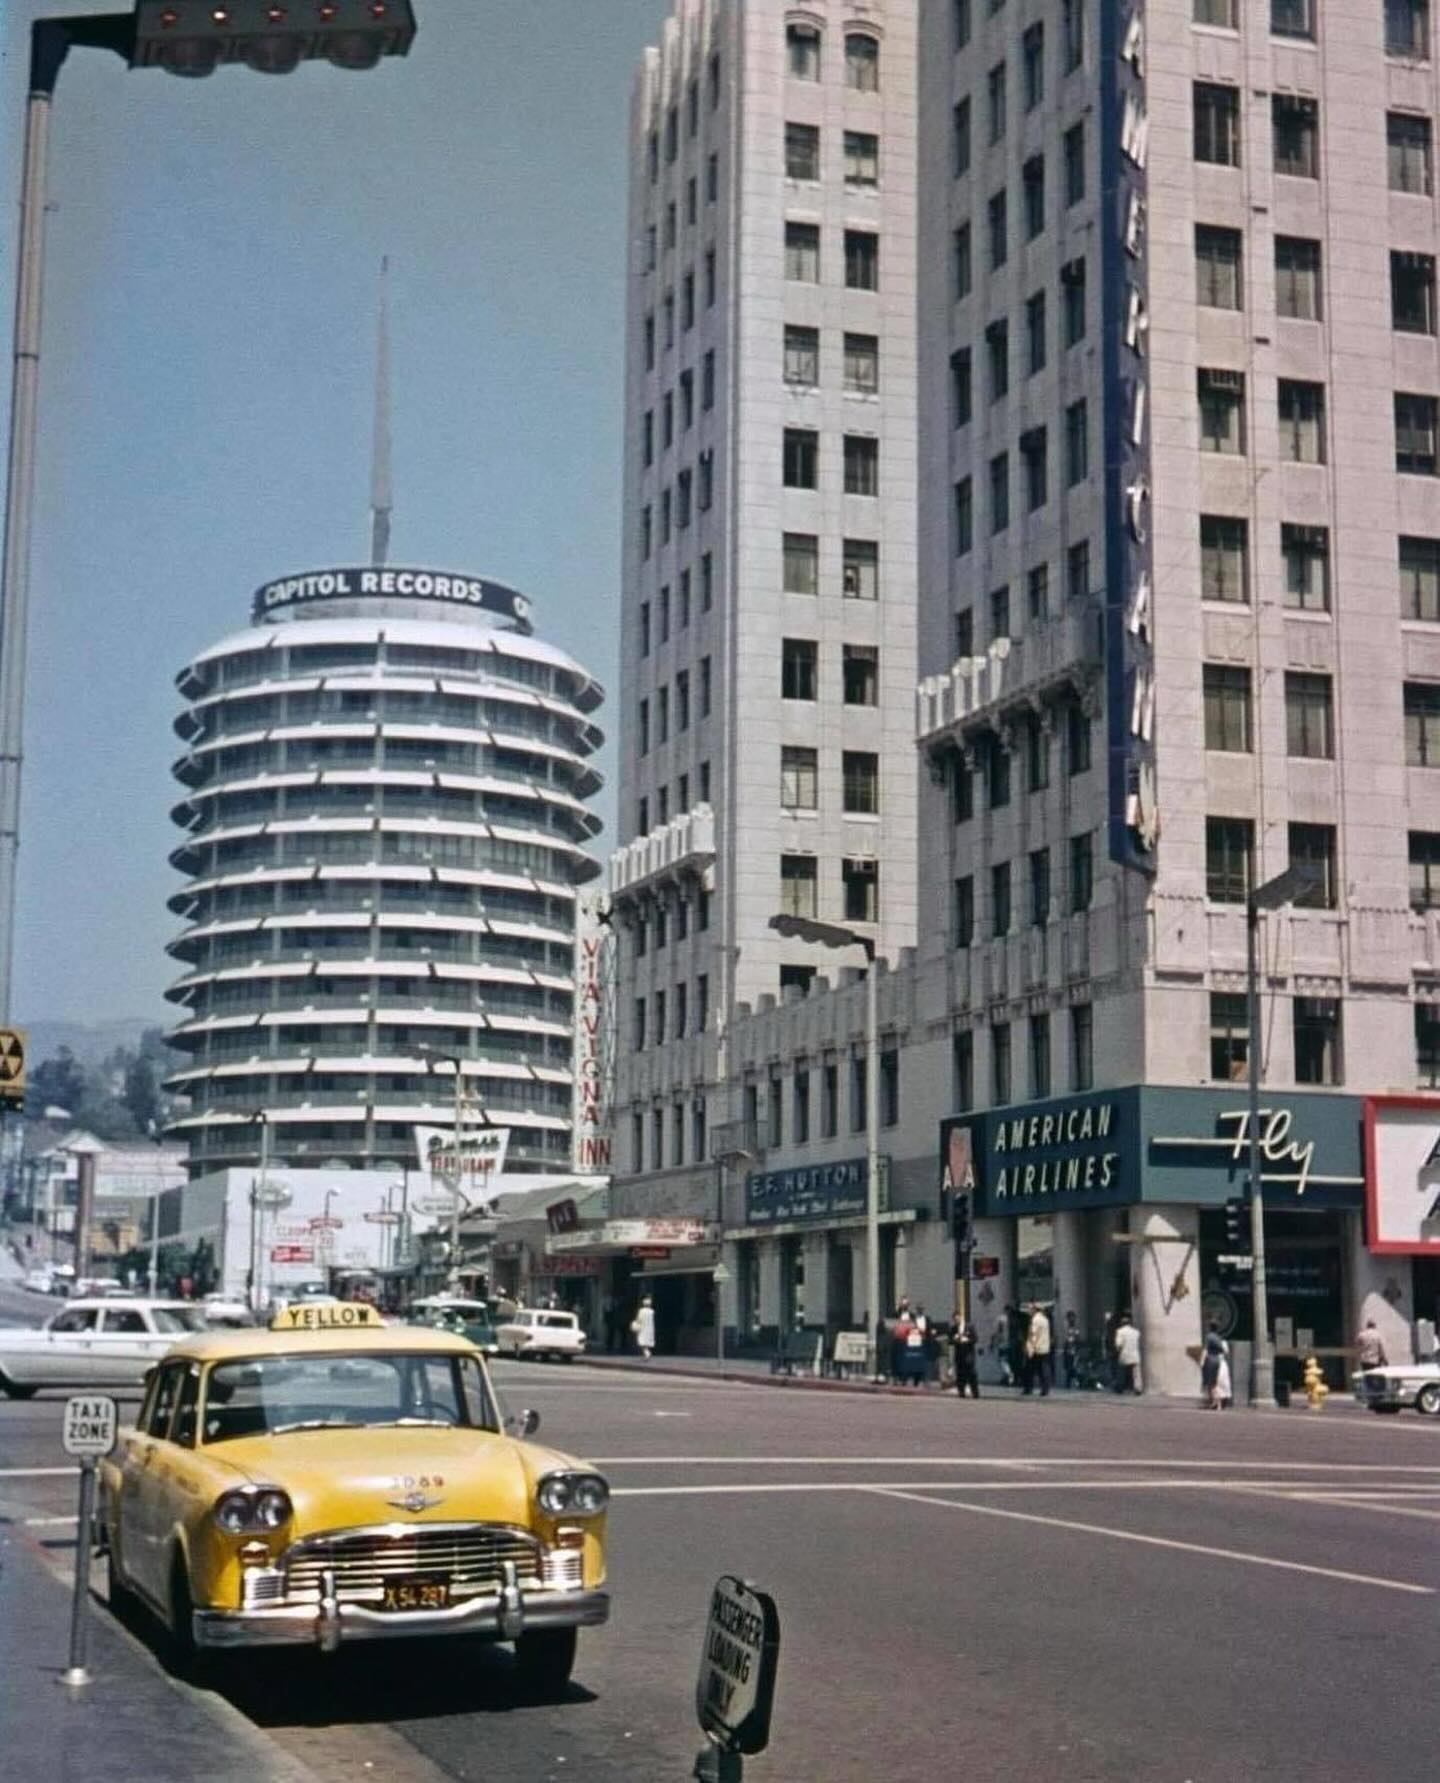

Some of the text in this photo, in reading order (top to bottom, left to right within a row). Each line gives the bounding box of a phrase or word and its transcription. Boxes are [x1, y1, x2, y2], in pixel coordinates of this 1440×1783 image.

[1120, 12, 1152, 742] AMERICAN
[264, 572, 483, 605] CAPITOL RECORDS
[994, 1104, 1111, 1152] AMERICAN
[580, 1138, 611, 1166] INN
[1219, 1108, 1315, 1195] Fly
[784, 1165, 860, 1192] HUTTON
[995, 1153, 1116, 1199] AIRLINES
[289, 1307, 369, 1326] YELLOW
[71, 1402, 110, 1418] TAXI
[69, 1423, 109, 1439] ZONE
